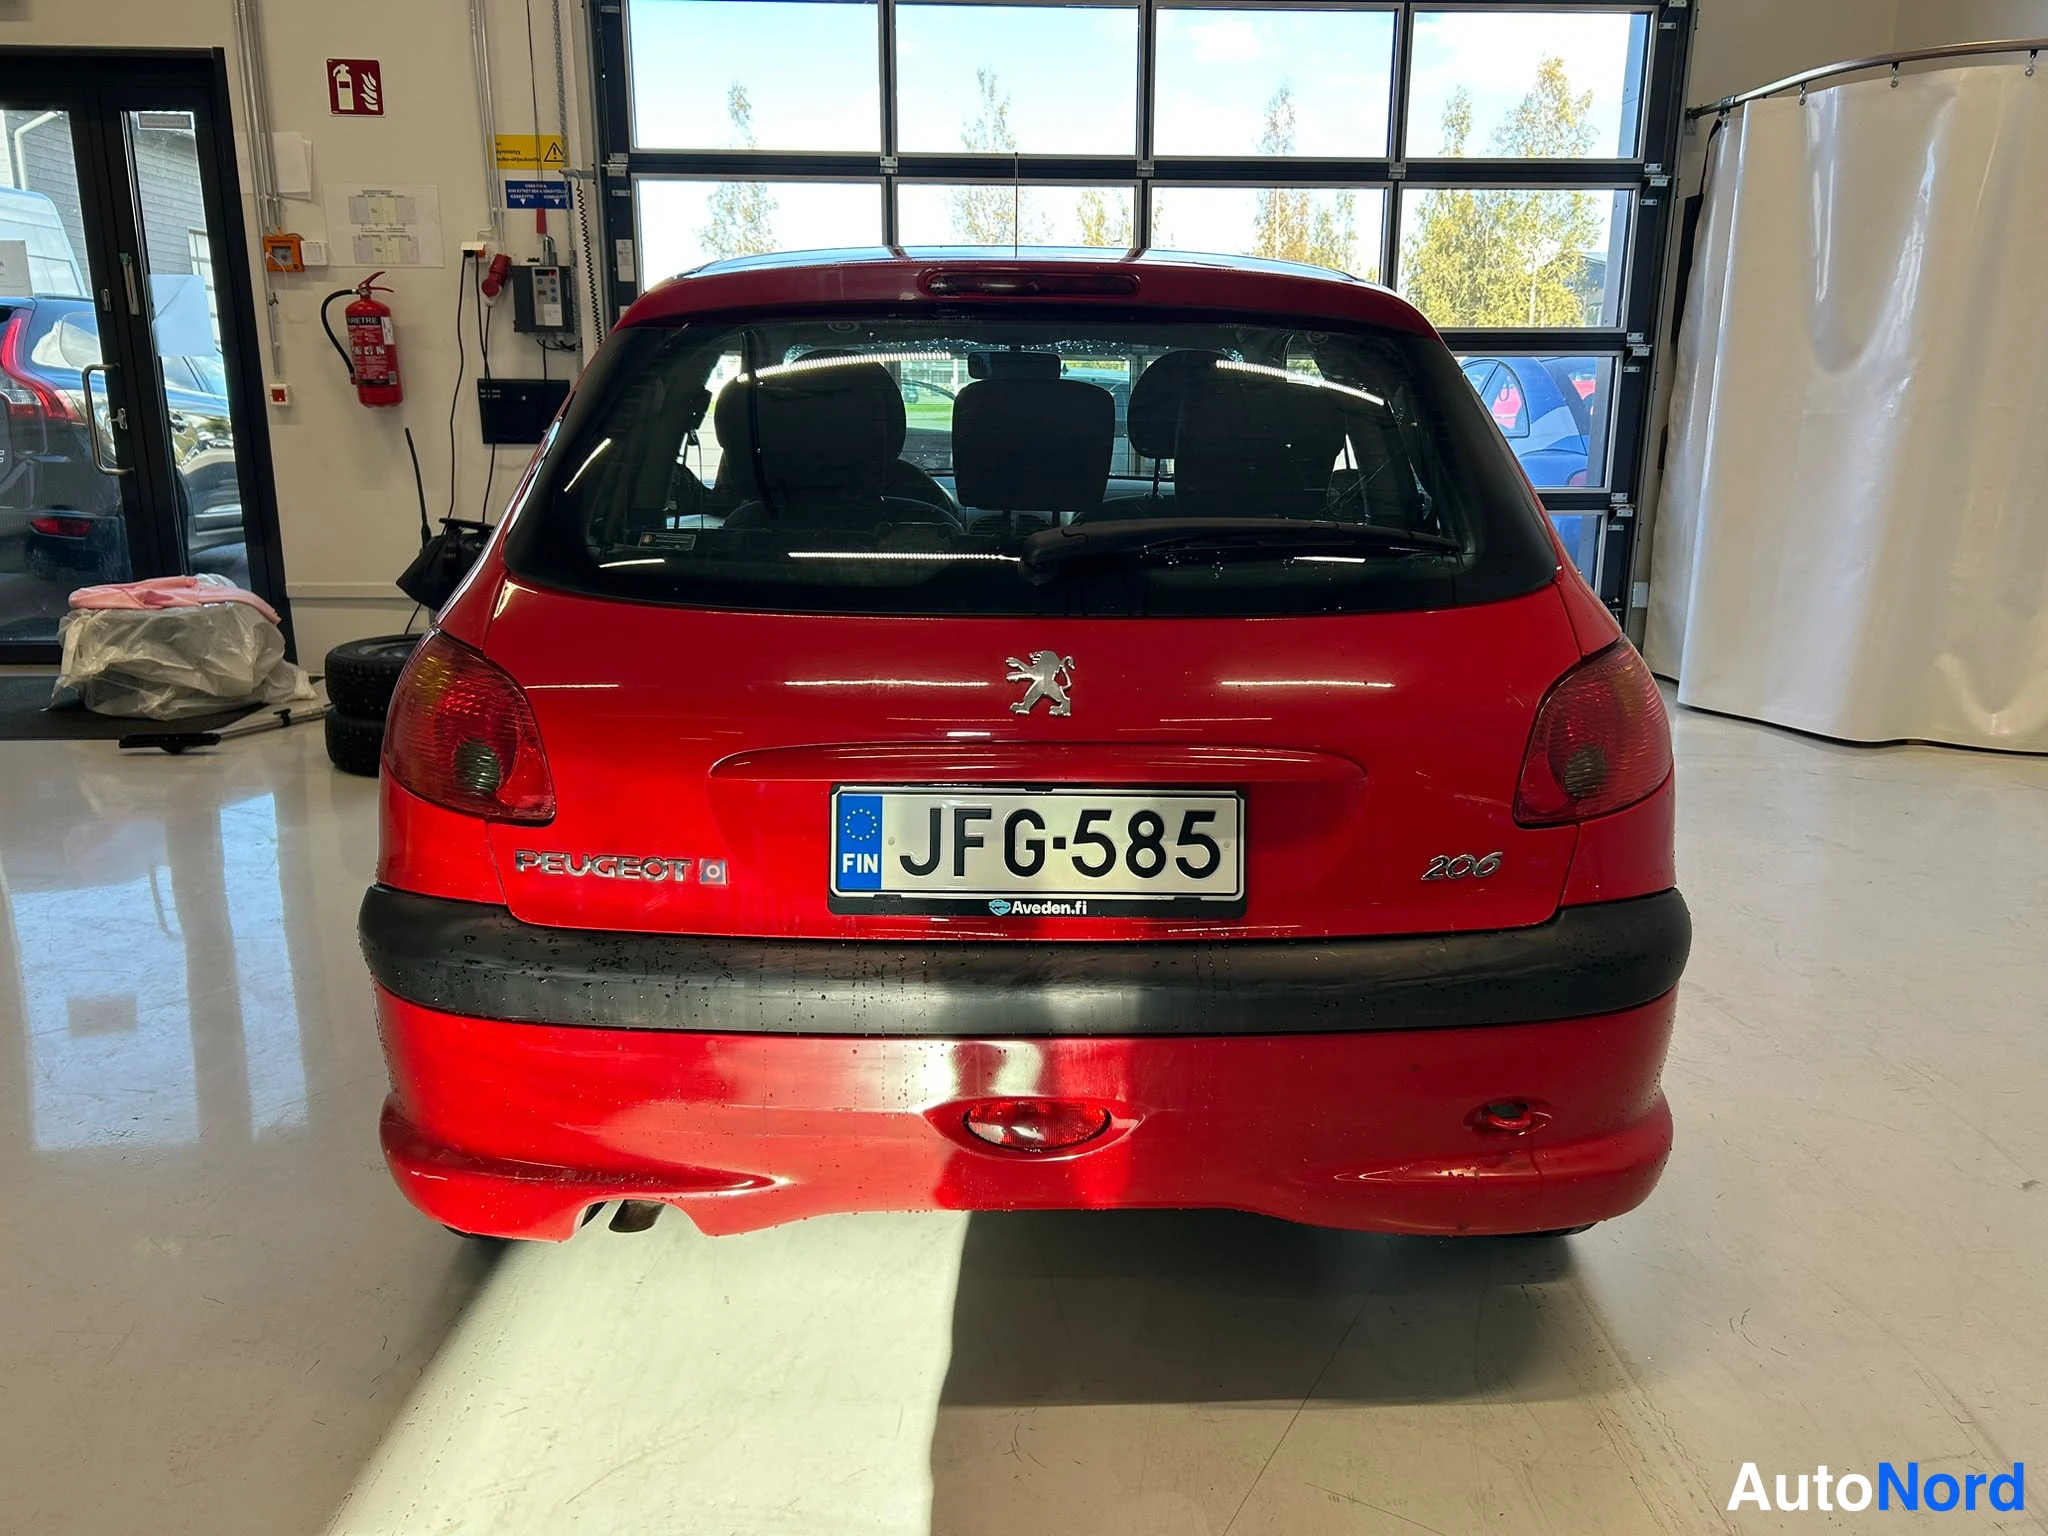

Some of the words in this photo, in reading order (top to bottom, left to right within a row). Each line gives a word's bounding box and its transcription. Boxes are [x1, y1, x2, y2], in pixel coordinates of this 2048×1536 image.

[900, 808, 1221, 879] JFG-585
[515, 849, 691, 882] PEUGEOT
[842, 853, 878, 873] FIN
[1421, 851, 1503, 880] 206
[1011, 899, 1087, 916] Aveden.fi
